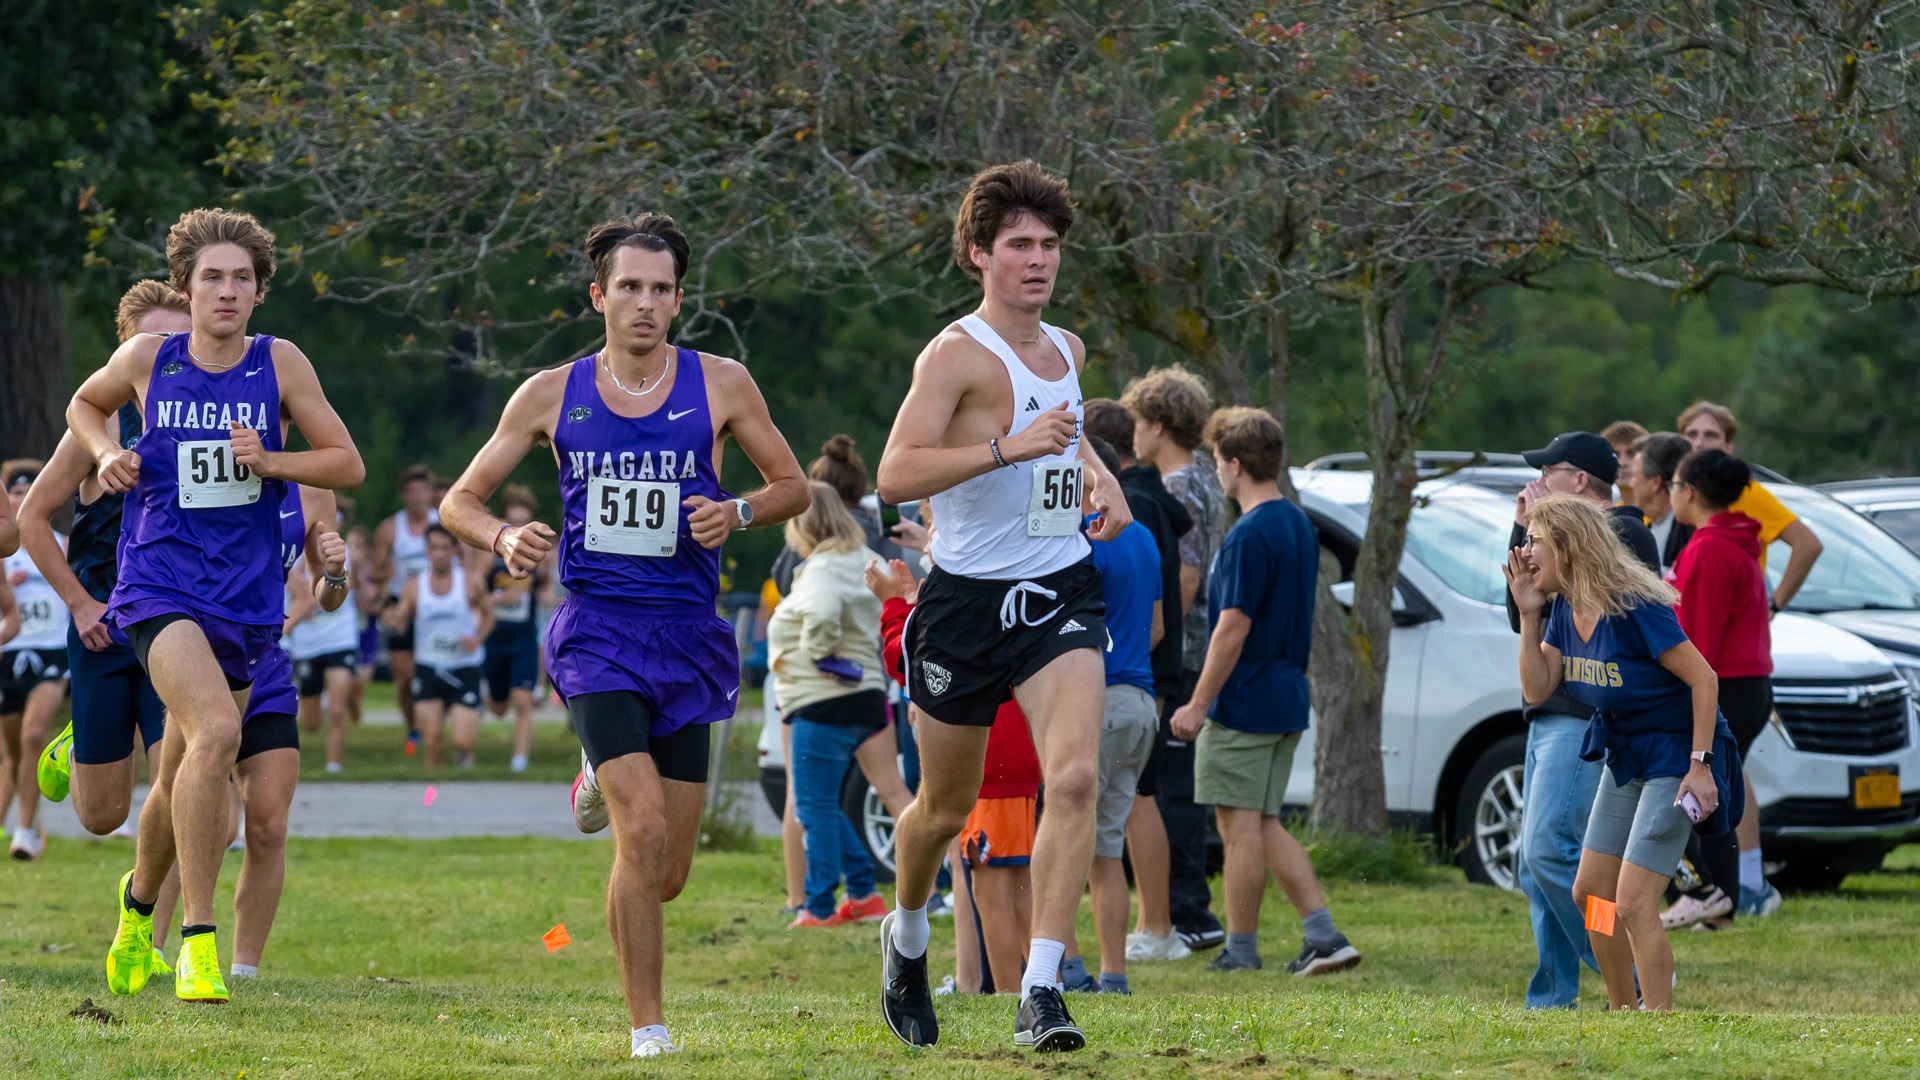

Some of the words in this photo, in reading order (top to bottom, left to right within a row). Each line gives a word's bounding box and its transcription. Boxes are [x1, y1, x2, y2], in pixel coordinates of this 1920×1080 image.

[157, 401, 268, 430] NIAGARA
[568, 450, 697, 480] NIAGARA
[1043, 467, 1082, 510] 560
[600, 485, 665, 530] 519
[1058, 626, 1087, 635] adidas
[922, 660, 952, 683] BONNIES
[1562, 655, 1623, 687] ANISIUS
